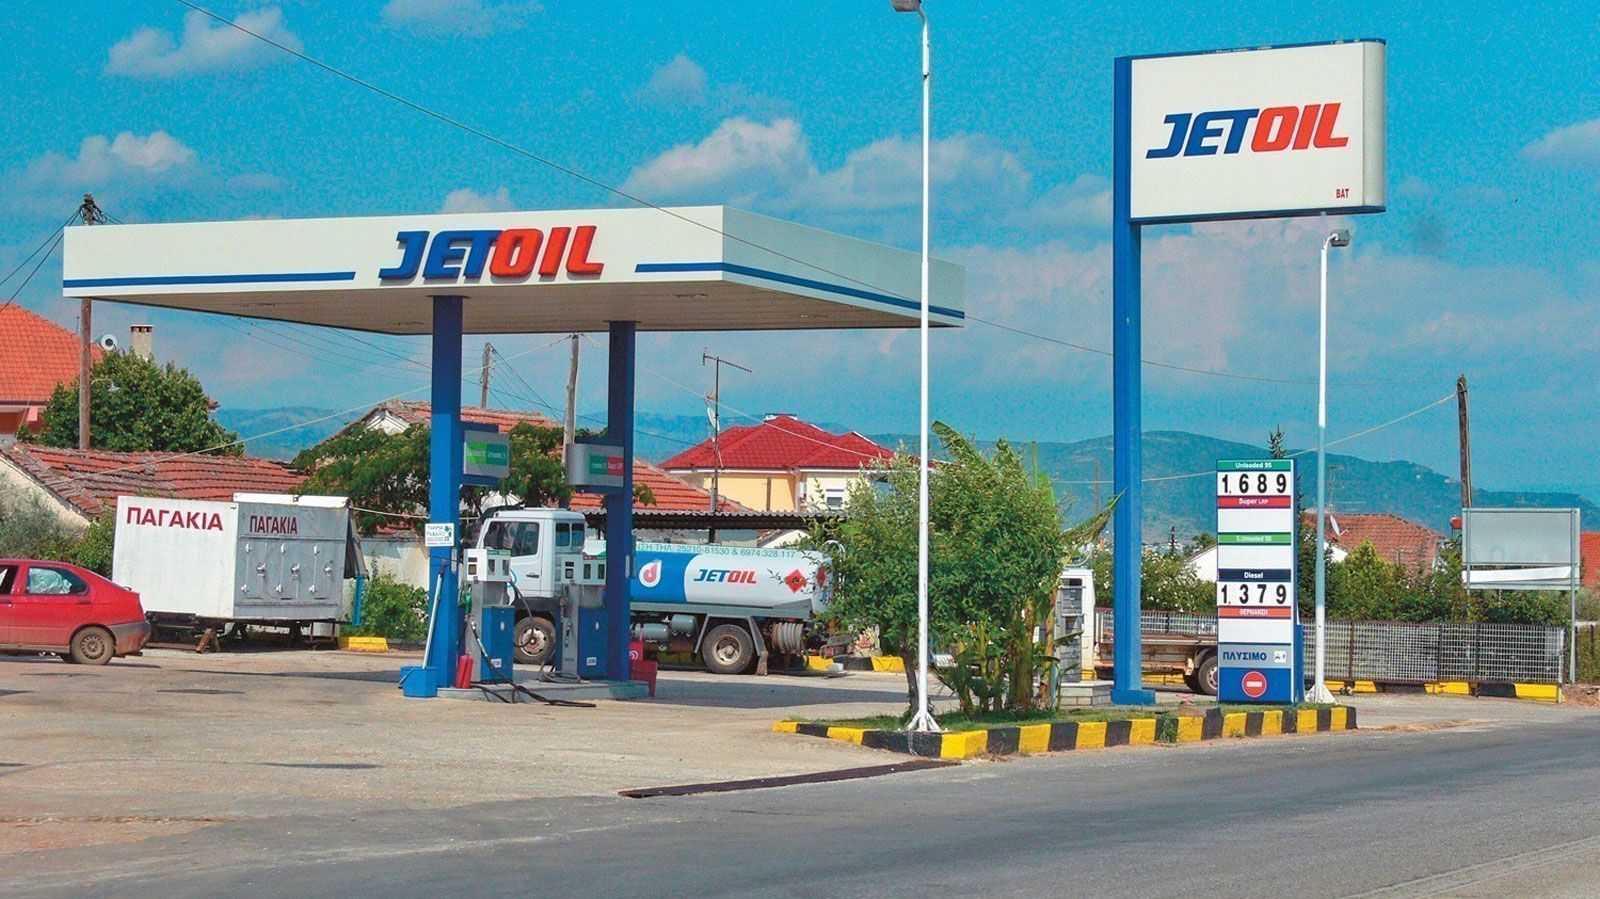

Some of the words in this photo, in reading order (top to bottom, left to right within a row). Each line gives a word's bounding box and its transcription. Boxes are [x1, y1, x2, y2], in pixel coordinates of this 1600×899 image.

[1146, 103, 1349, 159] JETOIL
[378, 226, 605, 280] JETOIL
[1238, 498, 1257, 506] Super
[126, 506, 224, 532] ΠΑΓΑΚΙΑ
[250, 515, 298, 535] ΠΑΓΑΚΙΑ
[694, 569, 757, 585] JETOIL
[1223, 651, 1267, 661] ΠΛΥΣΙΜΟ
